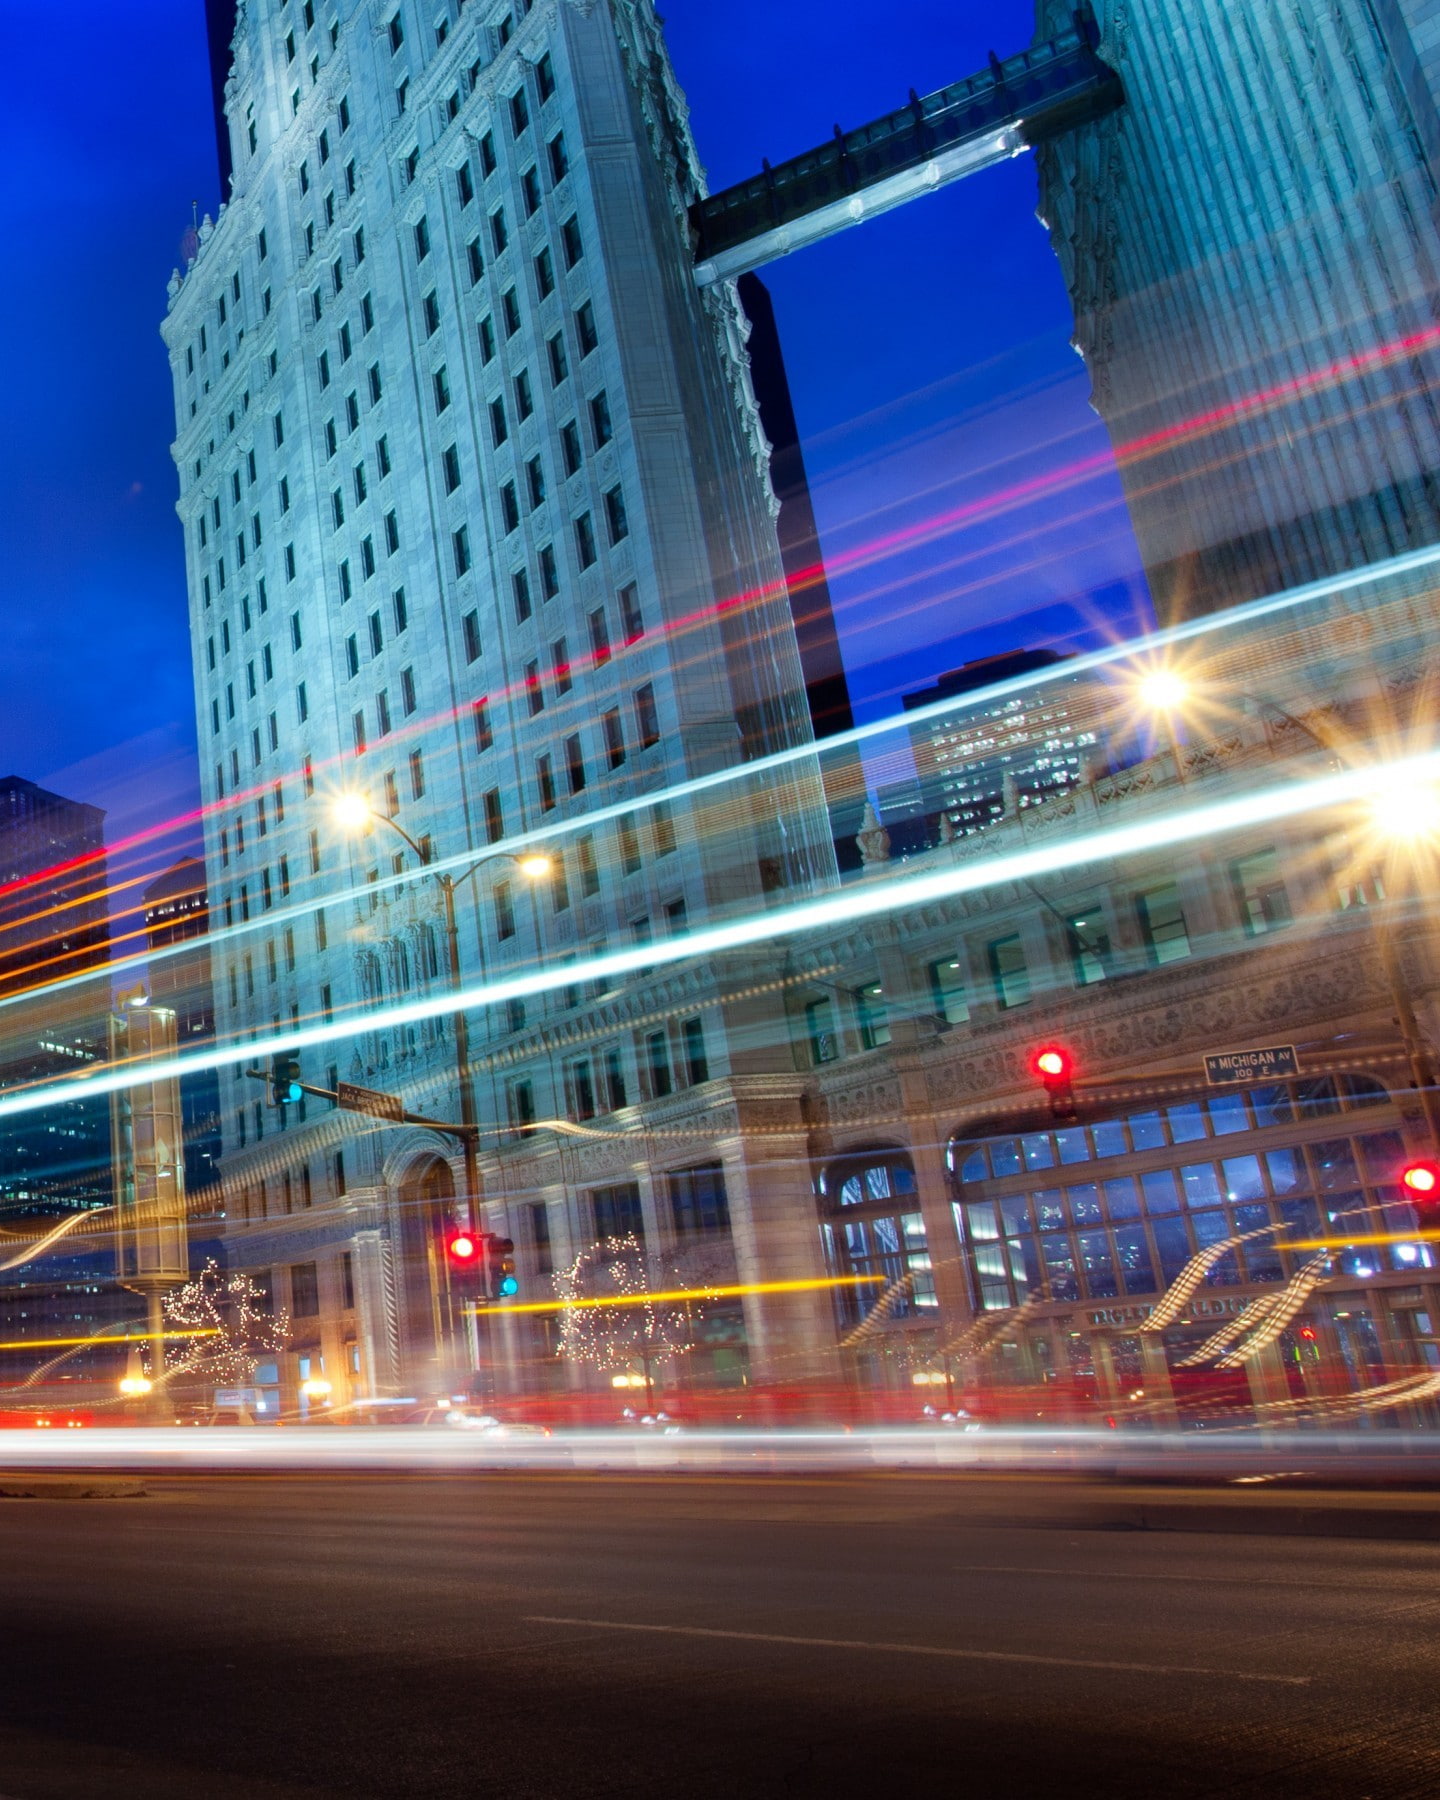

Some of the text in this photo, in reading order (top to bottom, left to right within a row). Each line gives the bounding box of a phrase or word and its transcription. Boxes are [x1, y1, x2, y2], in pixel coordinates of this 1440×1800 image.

[1209, 1051, 1290, 1069] N MICHIGAN AV
[1235, 1066, 1270, 1078] 100 E
